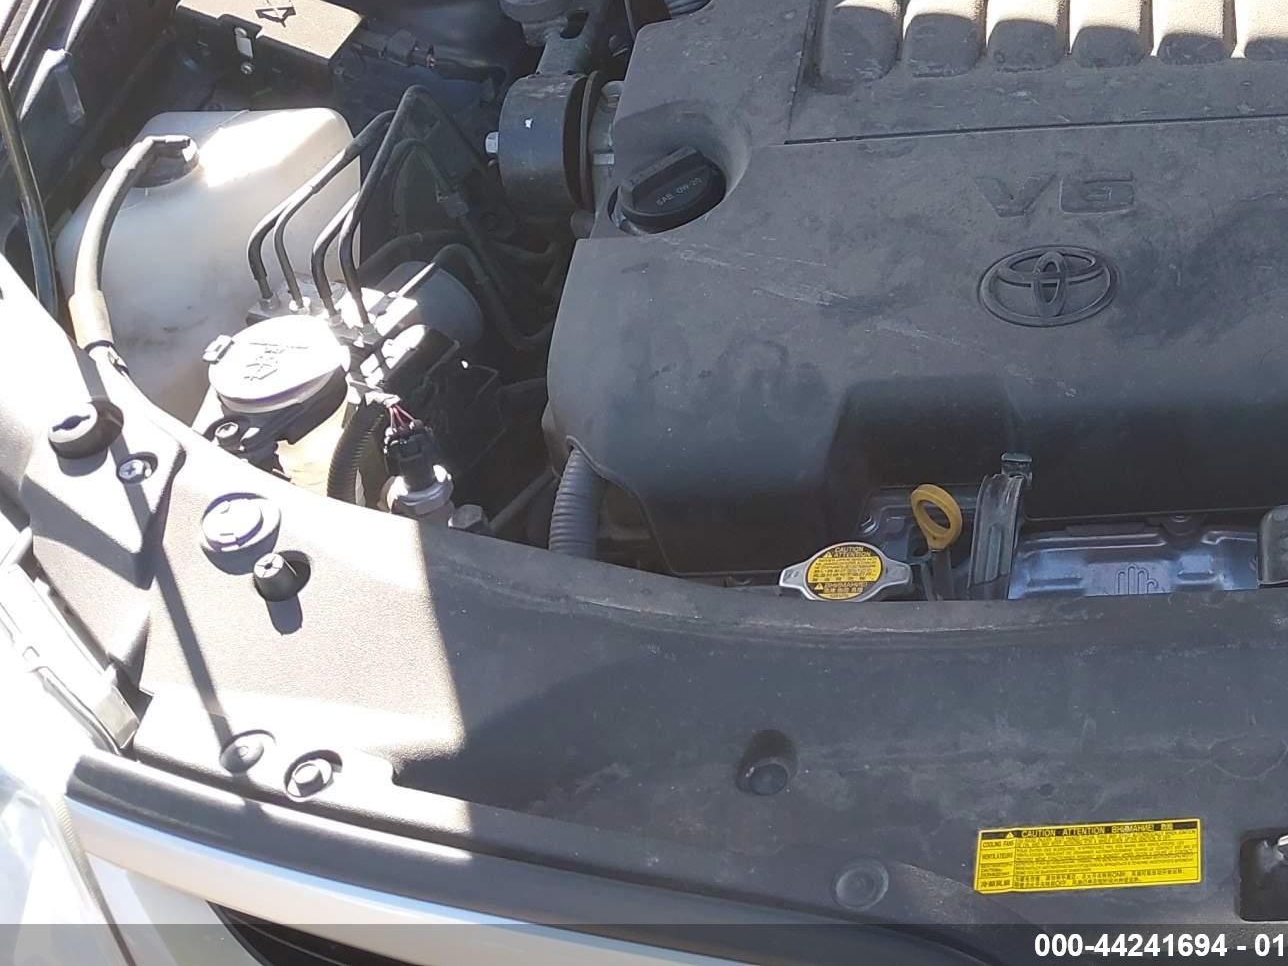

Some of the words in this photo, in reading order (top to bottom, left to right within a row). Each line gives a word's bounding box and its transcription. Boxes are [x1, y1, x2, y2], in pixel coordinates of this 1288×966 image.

[974, 170, 1136, 217] V6
[1021, 829, 1056, 838] CAUTION
[1062, 826, 1106, 837] ATTENTION
